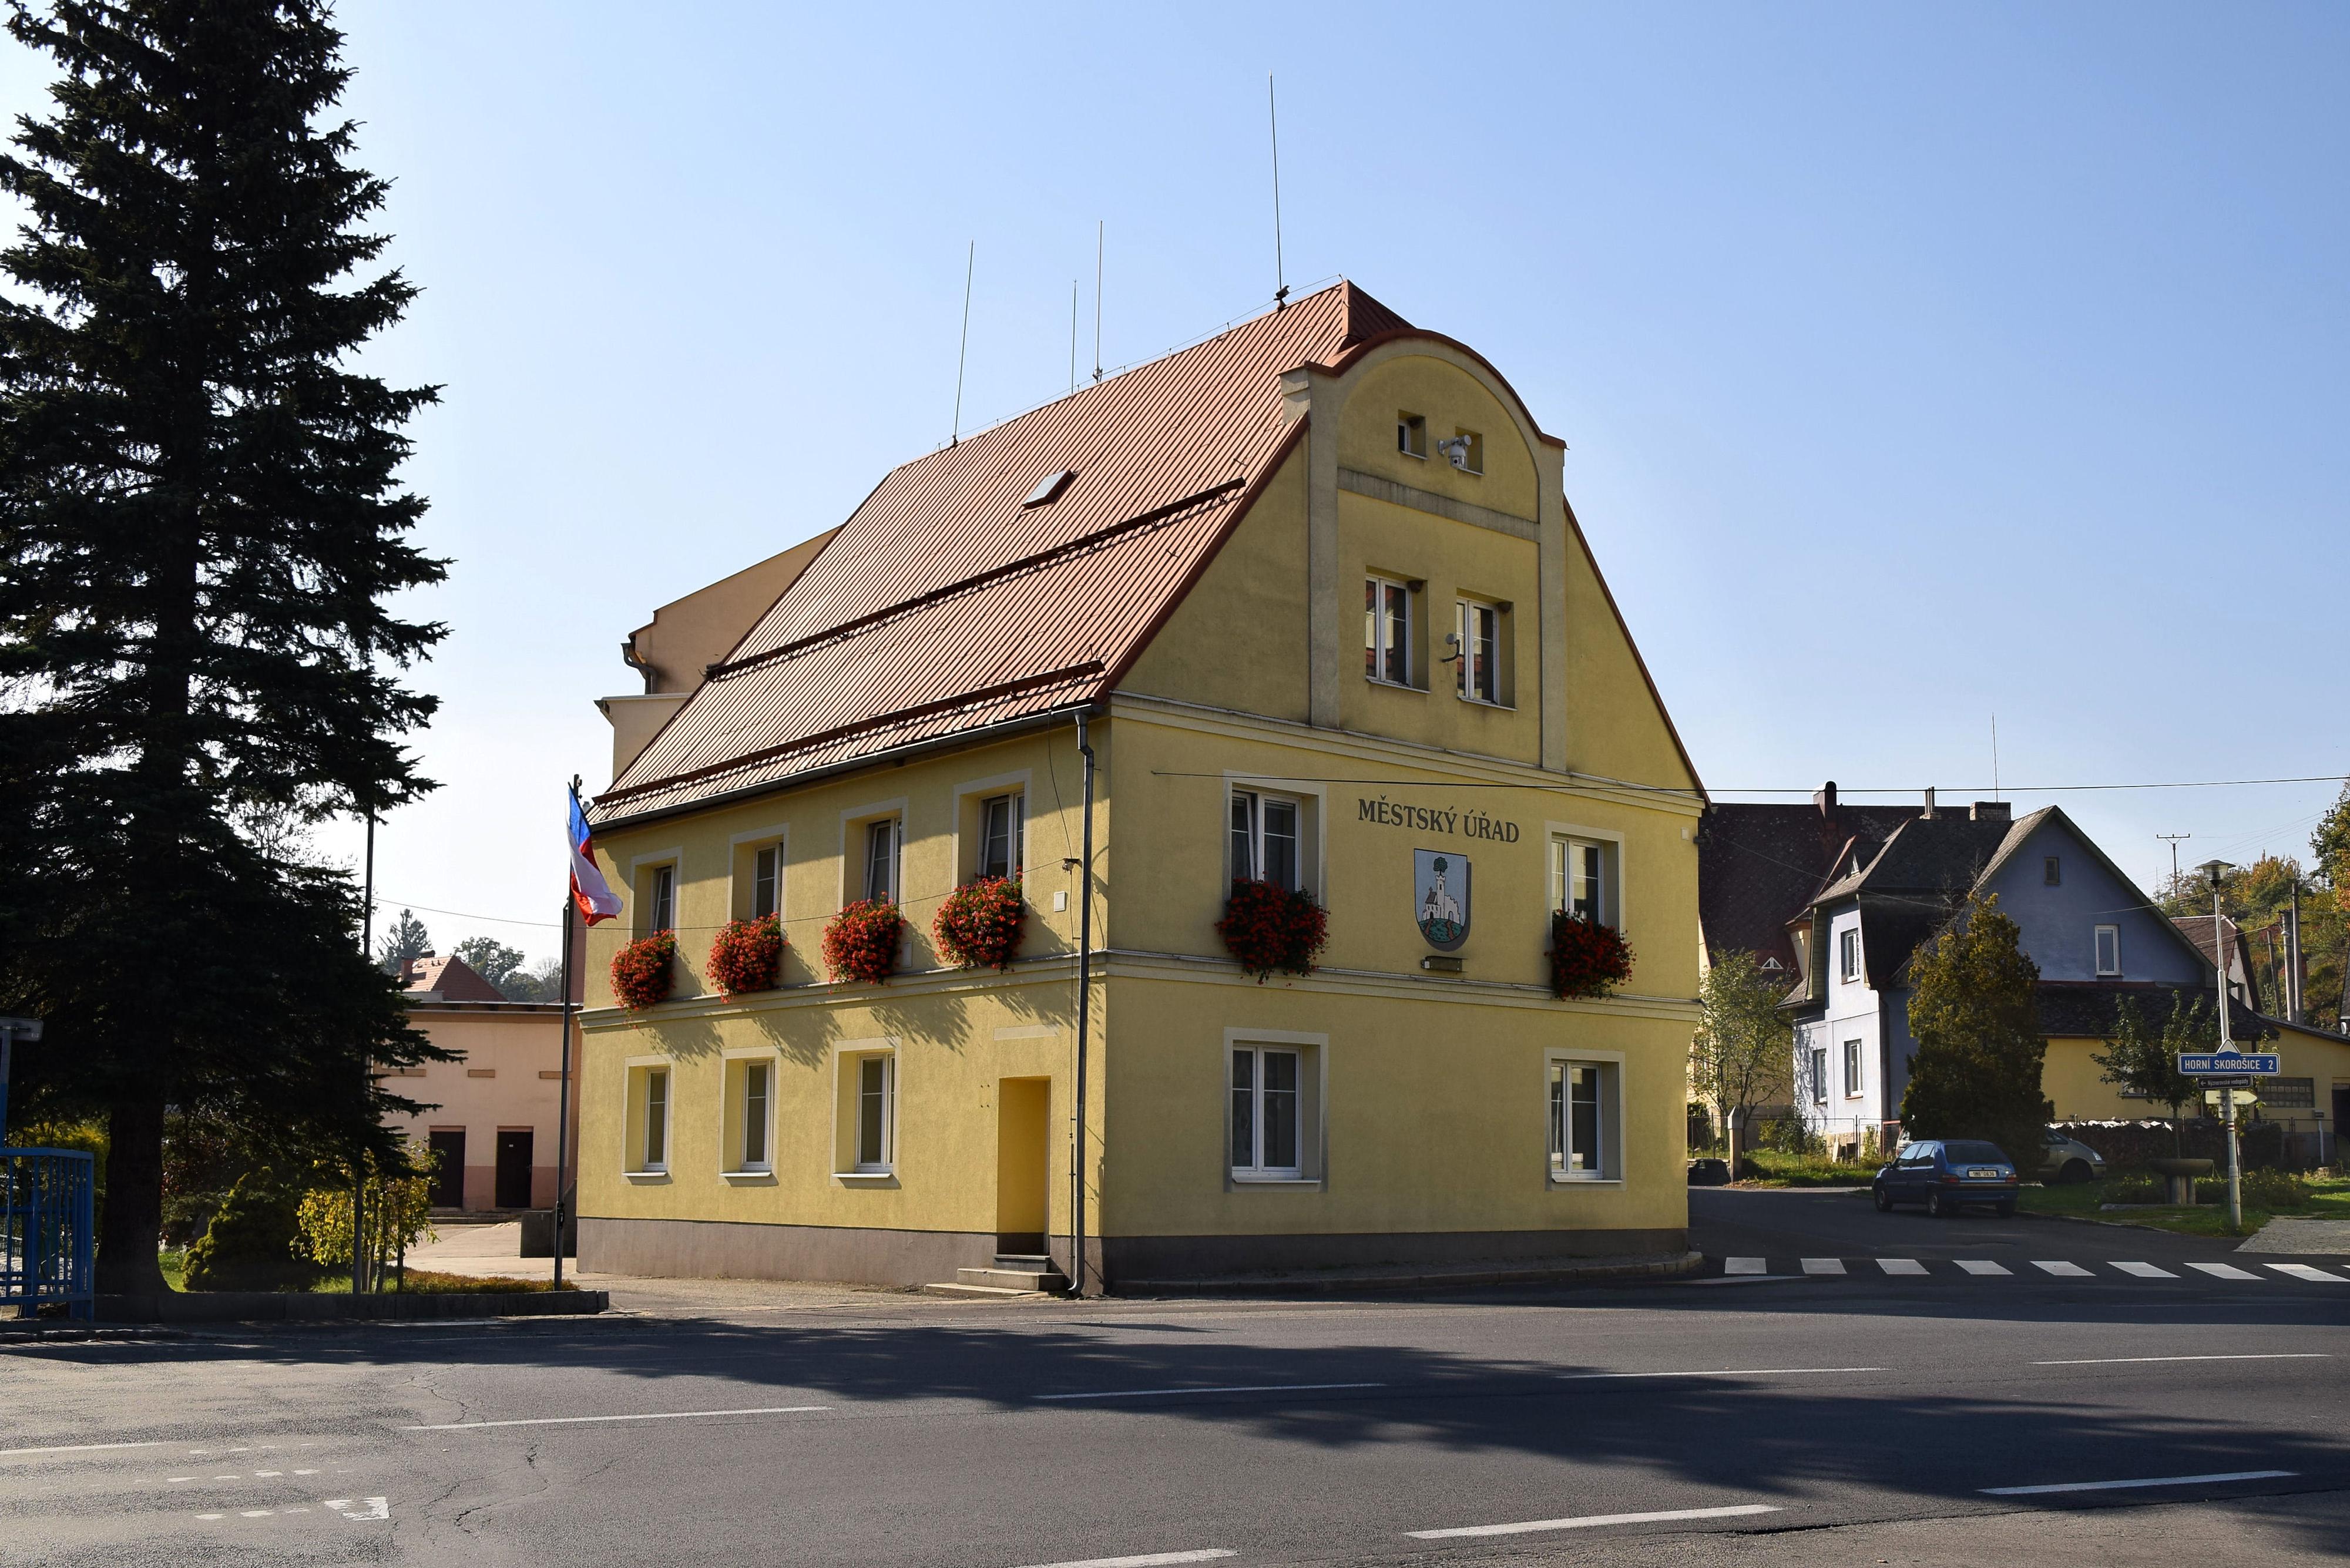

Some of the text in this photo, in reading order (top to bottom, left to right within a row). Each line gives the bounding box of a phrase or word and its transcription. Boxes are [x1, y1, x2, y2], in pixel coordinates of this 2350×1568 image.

[1358, 794, 1520, 843] MĚSTSKÝ ÚŘAD
[2185, 1058, 2274, 1070] HORNÍ SKOROŠICE 2
